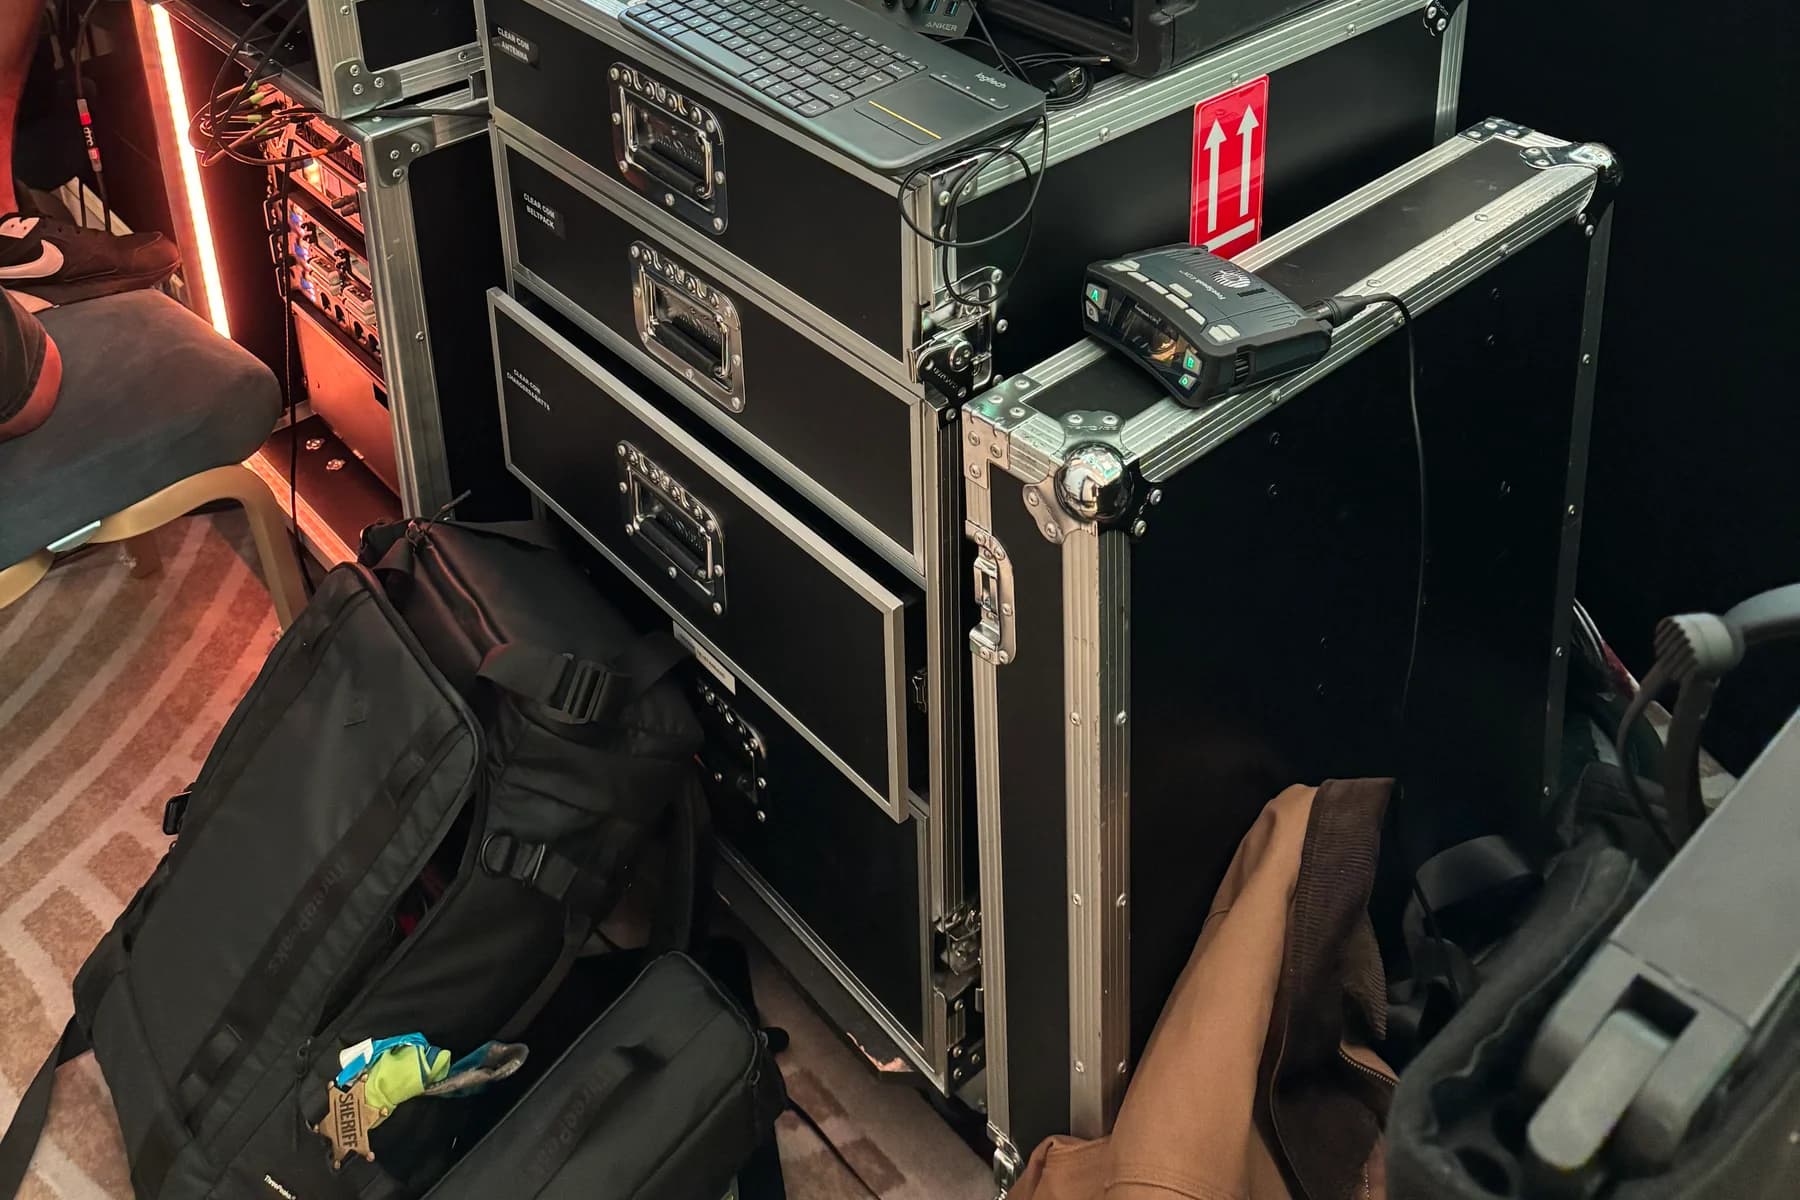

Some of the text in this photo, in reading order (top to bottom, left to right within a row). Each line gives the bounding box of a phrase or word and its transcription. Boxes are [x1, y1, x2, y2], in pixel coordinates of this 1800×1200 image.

[925, 21, 958, 32] ANKER
[498, 26, 530, 51] CLEAR COM
[501, 41, 529, 62] ANTENNA
[975, 71, 1007, 89] logitech
[523, 192, 555, 219] CLEAR COM
[526, 205, 555, 230] BELTPACK
[1091, 289, 1099, 302] A
[1186, 356, 1194, 369] B
[513, 369, 530, 386] CLEAR
[338, 1092, 359, 1150] SHERIFF
